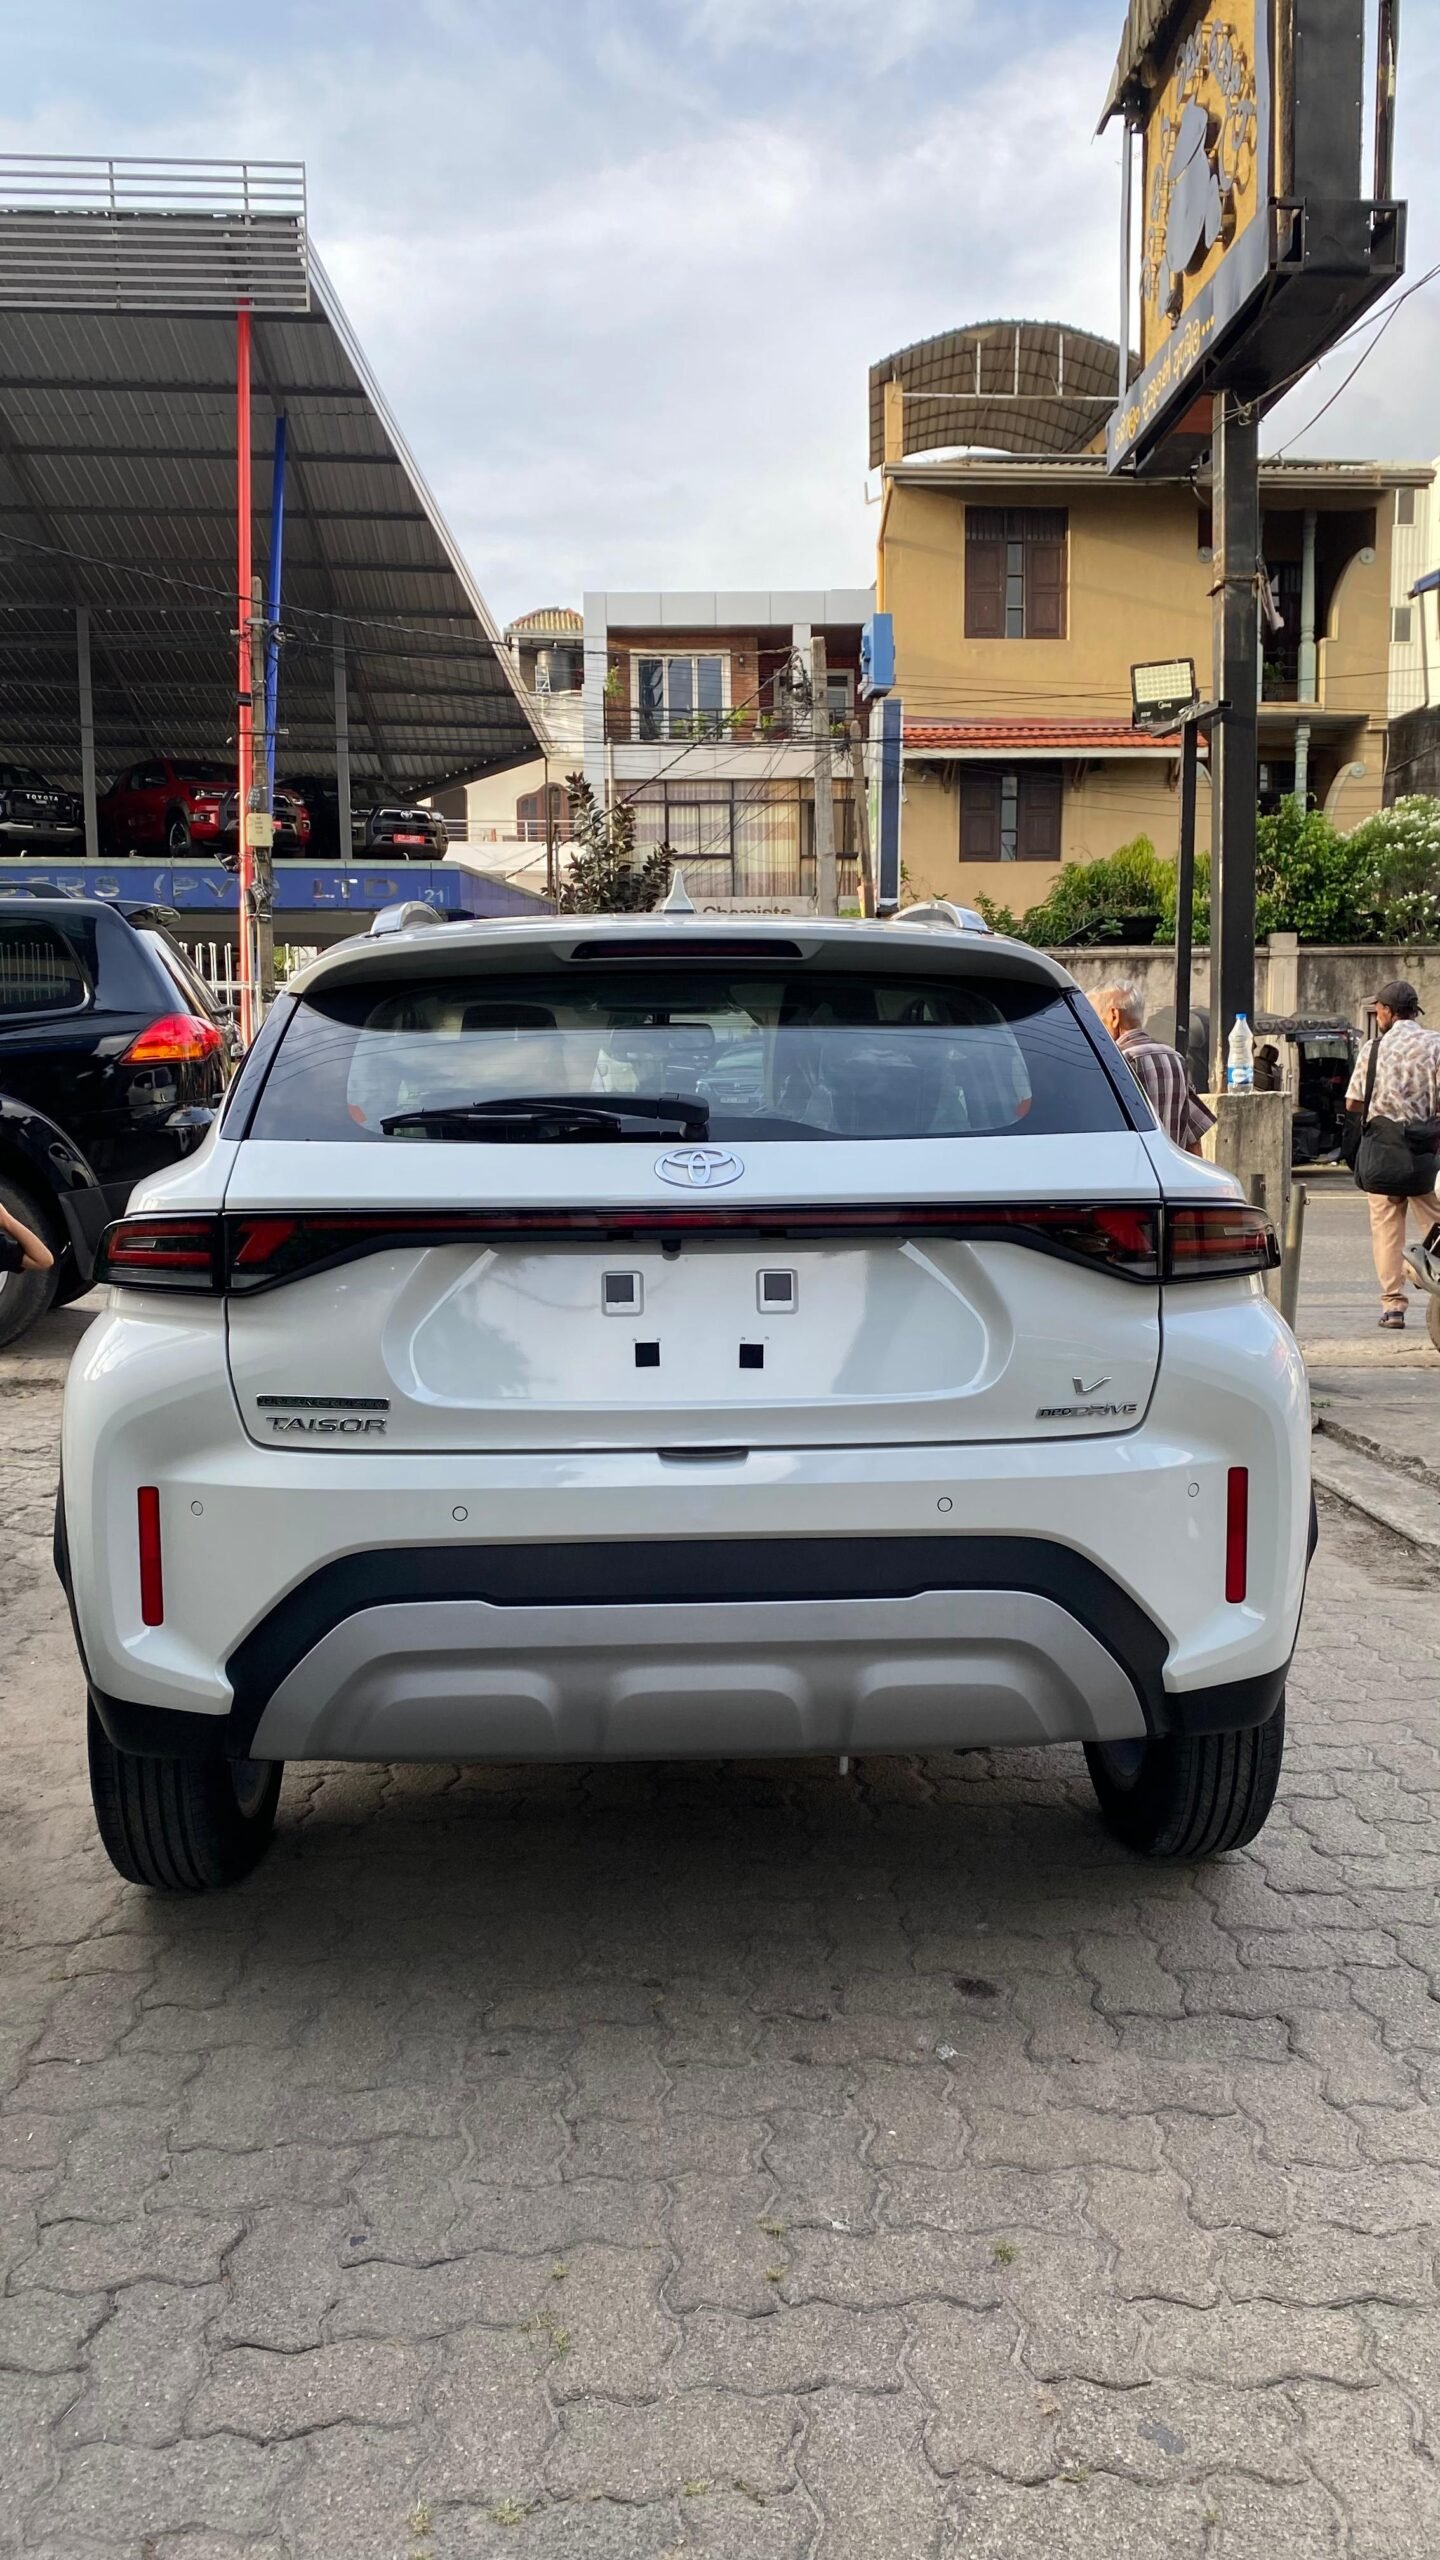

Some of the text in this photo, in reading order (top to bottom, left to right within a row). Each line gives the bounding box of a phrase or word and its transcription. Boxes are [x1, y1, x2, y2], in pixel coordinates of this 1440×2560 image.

[25, 793, 59, 801] TOYOTA
[313, 878, 399, 899] LTD
[423, 889, 444, 903] 21
[265, 1415, 388, 1434] TAISOR
